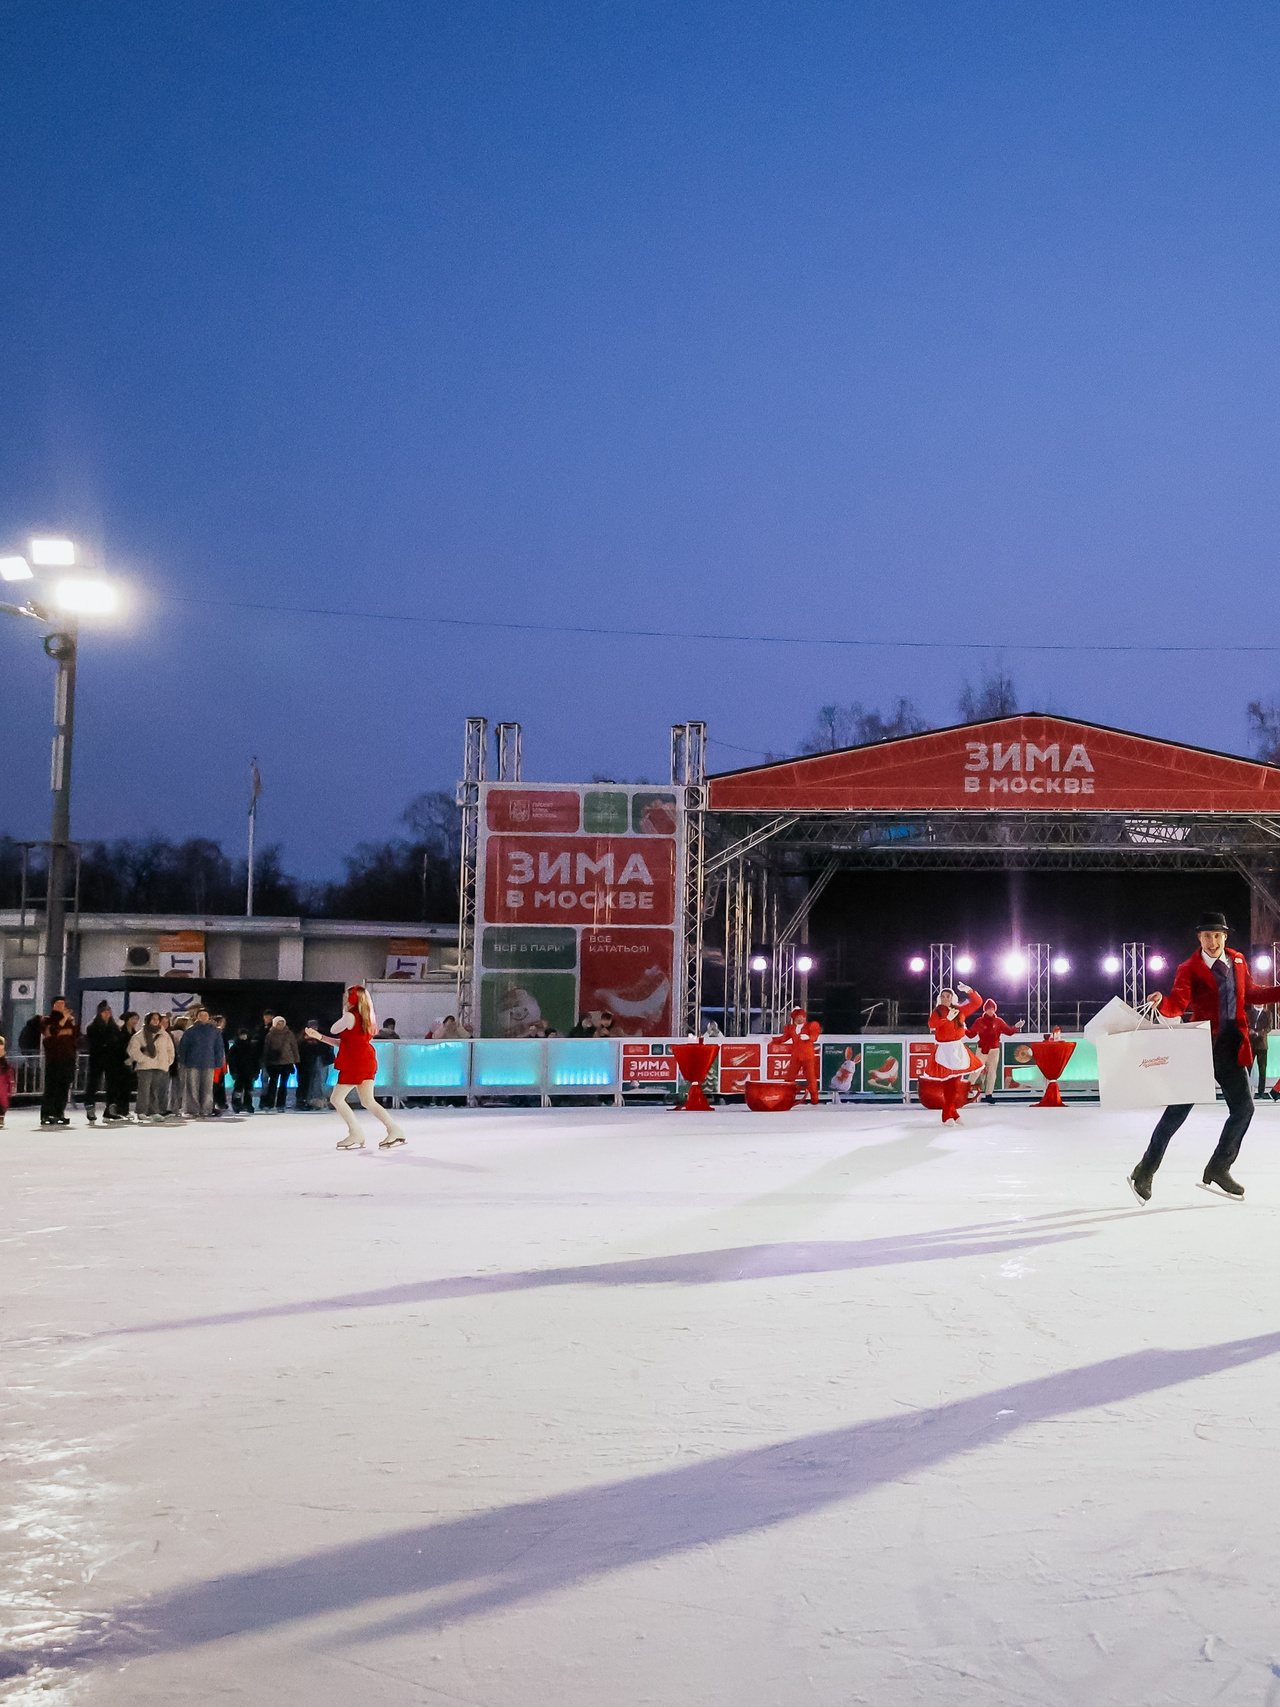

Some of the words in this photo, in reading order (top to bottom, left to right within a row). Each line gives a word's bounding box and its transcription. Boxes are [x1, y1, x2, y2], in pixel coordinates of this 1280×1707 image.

[964, 741, 1095, 772] ЗИМА
[964, 776, 980, 793] В
[989, 776, 1095, 794] МОСКВЕ
[506, 851, 654, 885] ЗИМА
[506, 890, 525, 908] В
[534, 890, 654, 909] МОСКВЕ
[589, 935, 611, 943] ВСЕ
[589, 945, 649, 953] КАТАТЬСЯ!
[630, 1060, 670, 1071] ЗИМА
